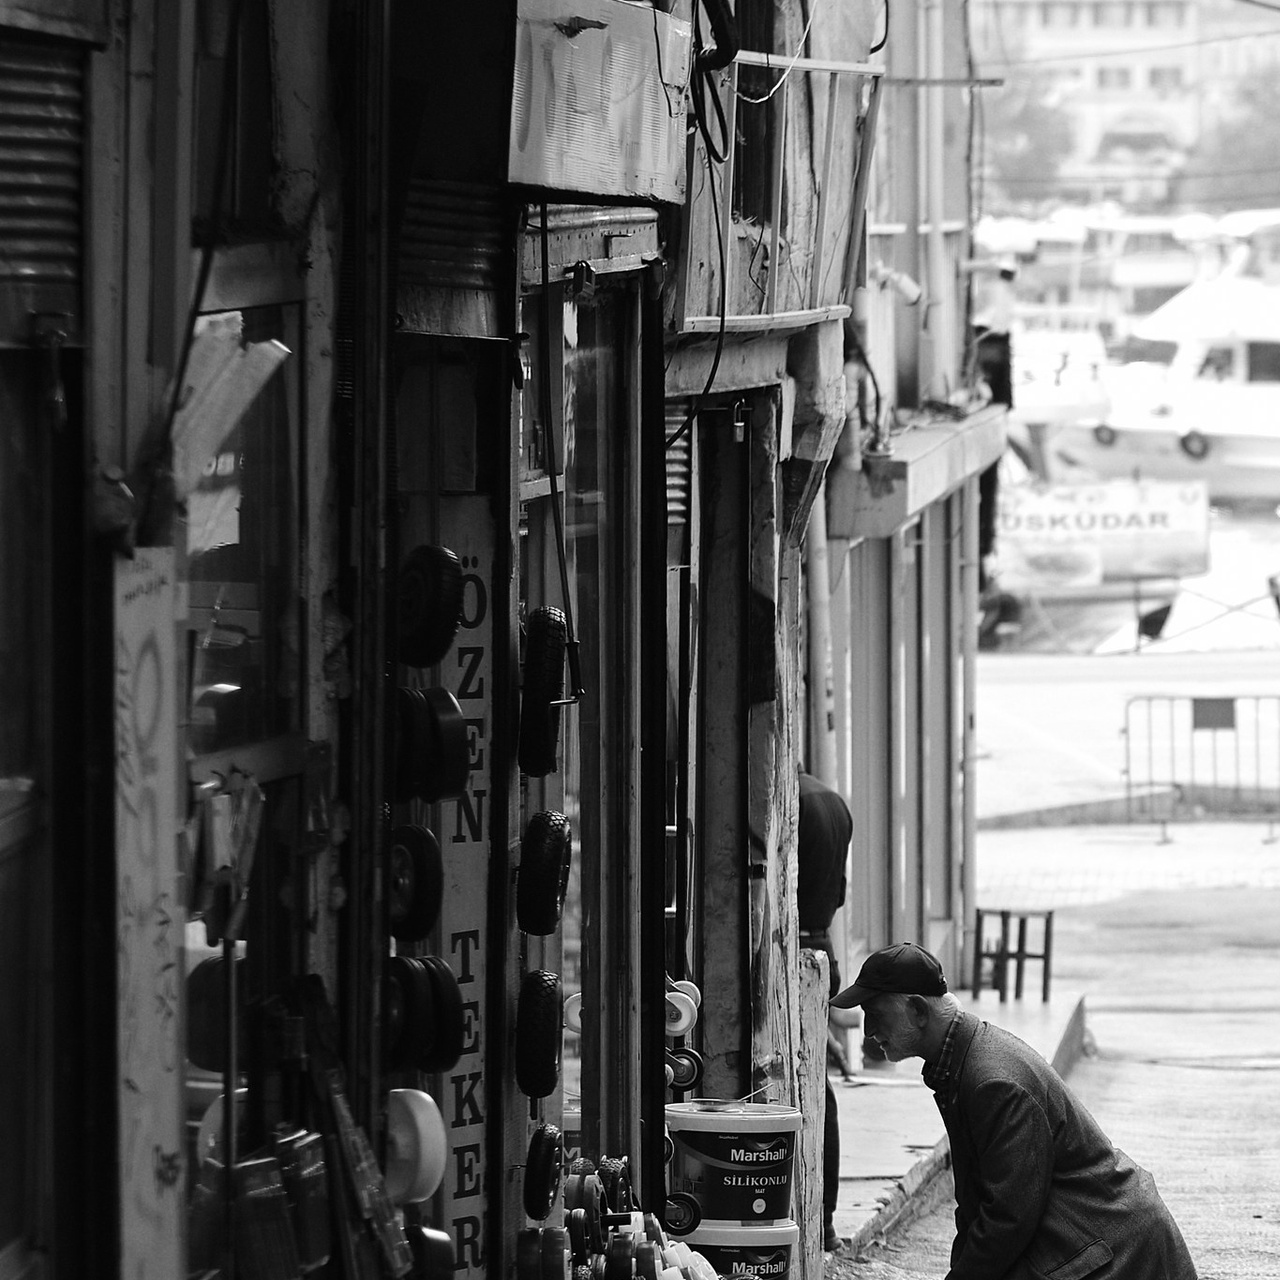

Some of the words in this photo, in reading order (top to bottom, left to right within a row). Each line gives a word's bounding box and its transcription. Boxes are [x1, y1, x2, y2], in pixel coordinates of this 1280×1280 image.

[452, 556, 487, 844] ÖZEN
[451, 929, 484, 1270] TEKER
[731, 1148, 785, 1162] Marshall
[723, 1174, 788, 1186] SİLİKONLU
[732, 1261, 785, 1275] Marshall
